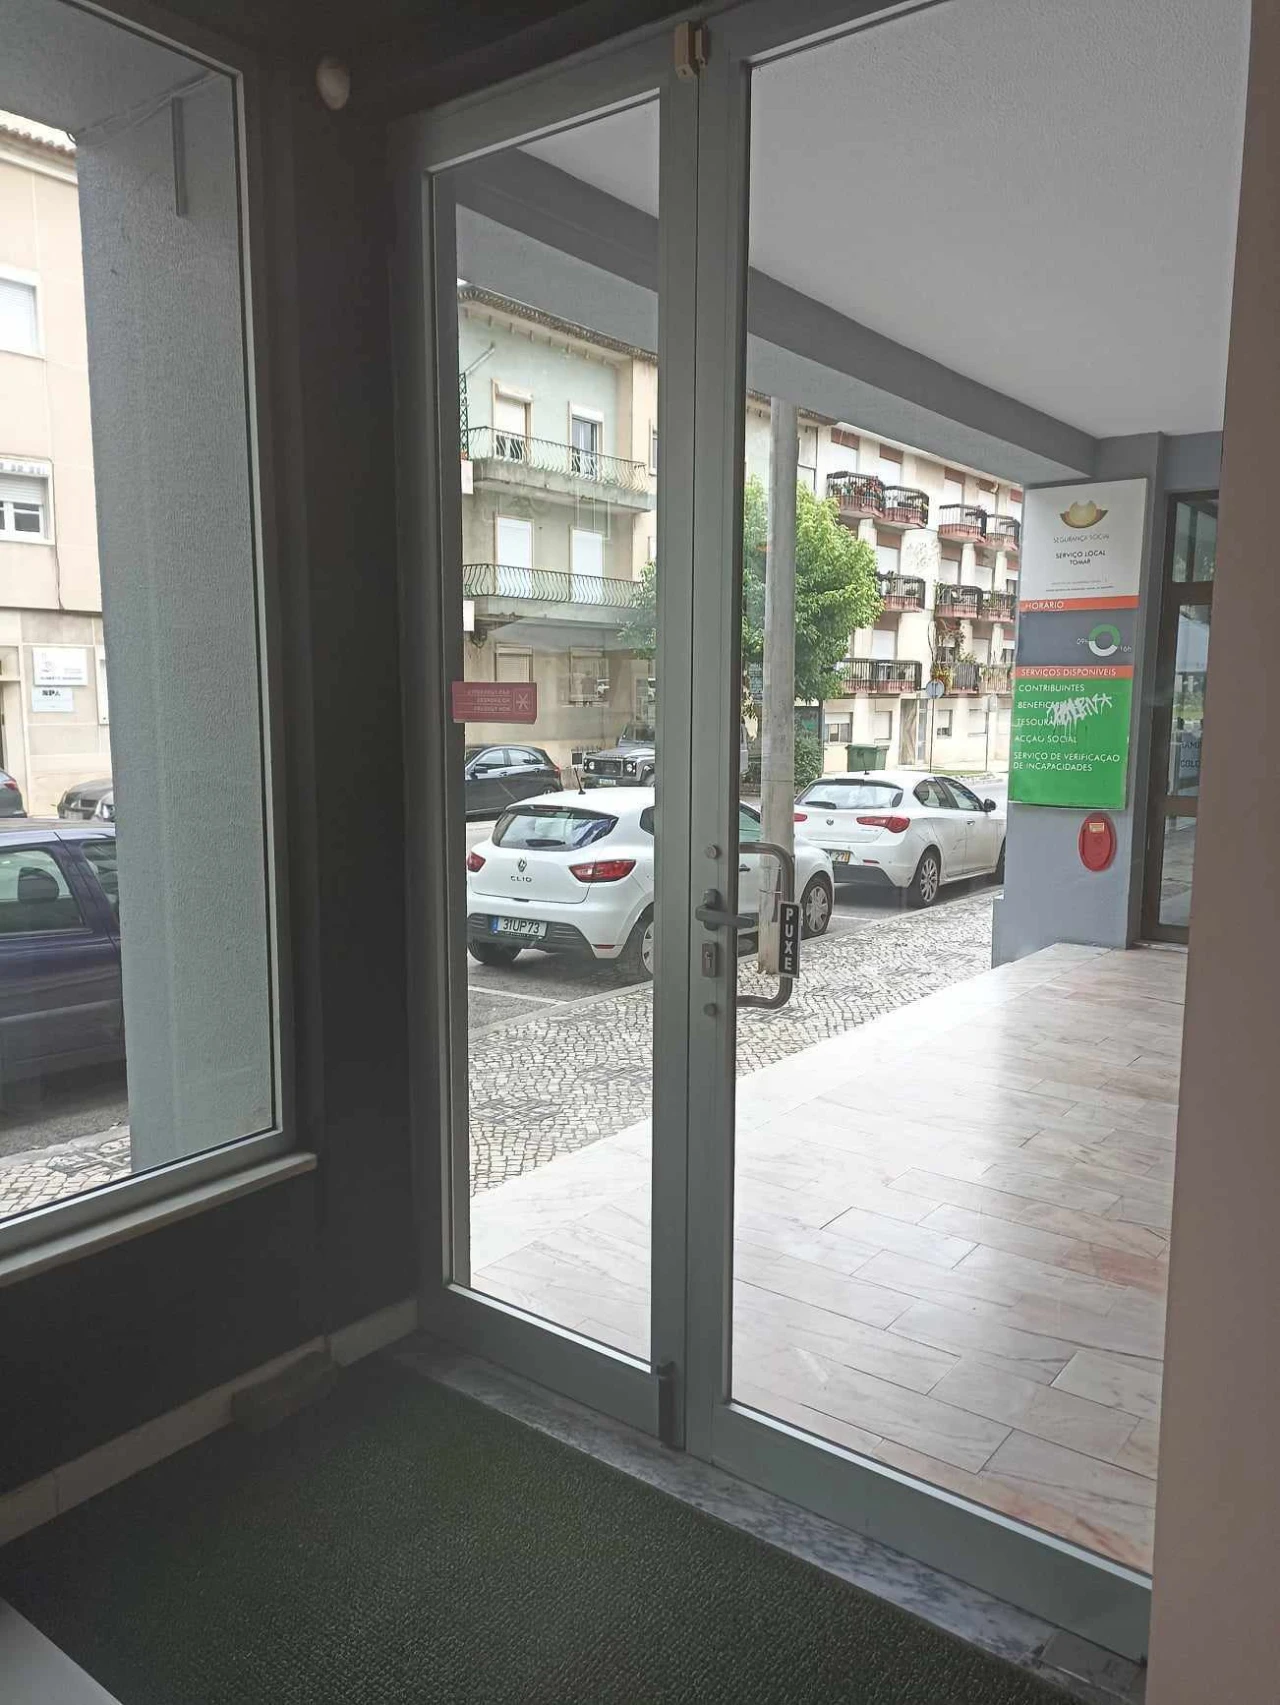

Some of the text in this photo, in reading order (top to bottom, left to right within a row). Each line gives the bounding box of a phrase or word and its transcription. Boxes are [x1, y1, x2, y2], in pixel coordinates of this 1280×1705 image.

[1055, 551, 1083, 559] SERVIÇO
[1070, 558, 1091, 566] TOMAR
[1021, 668, 1061, 677] SERVIÇOS
[1018, 684, 1085, 692] CONTRIBUINTES
[1047, 735, 1077, 743] SOCIAL
[1013, 752, 1048, 760] SERVIÇO
[1026, 762, 1093, 772] INCAPACIDADES
[510, 875, 532, 883] CLIO
[784, 907, 794, 972] PUXE
